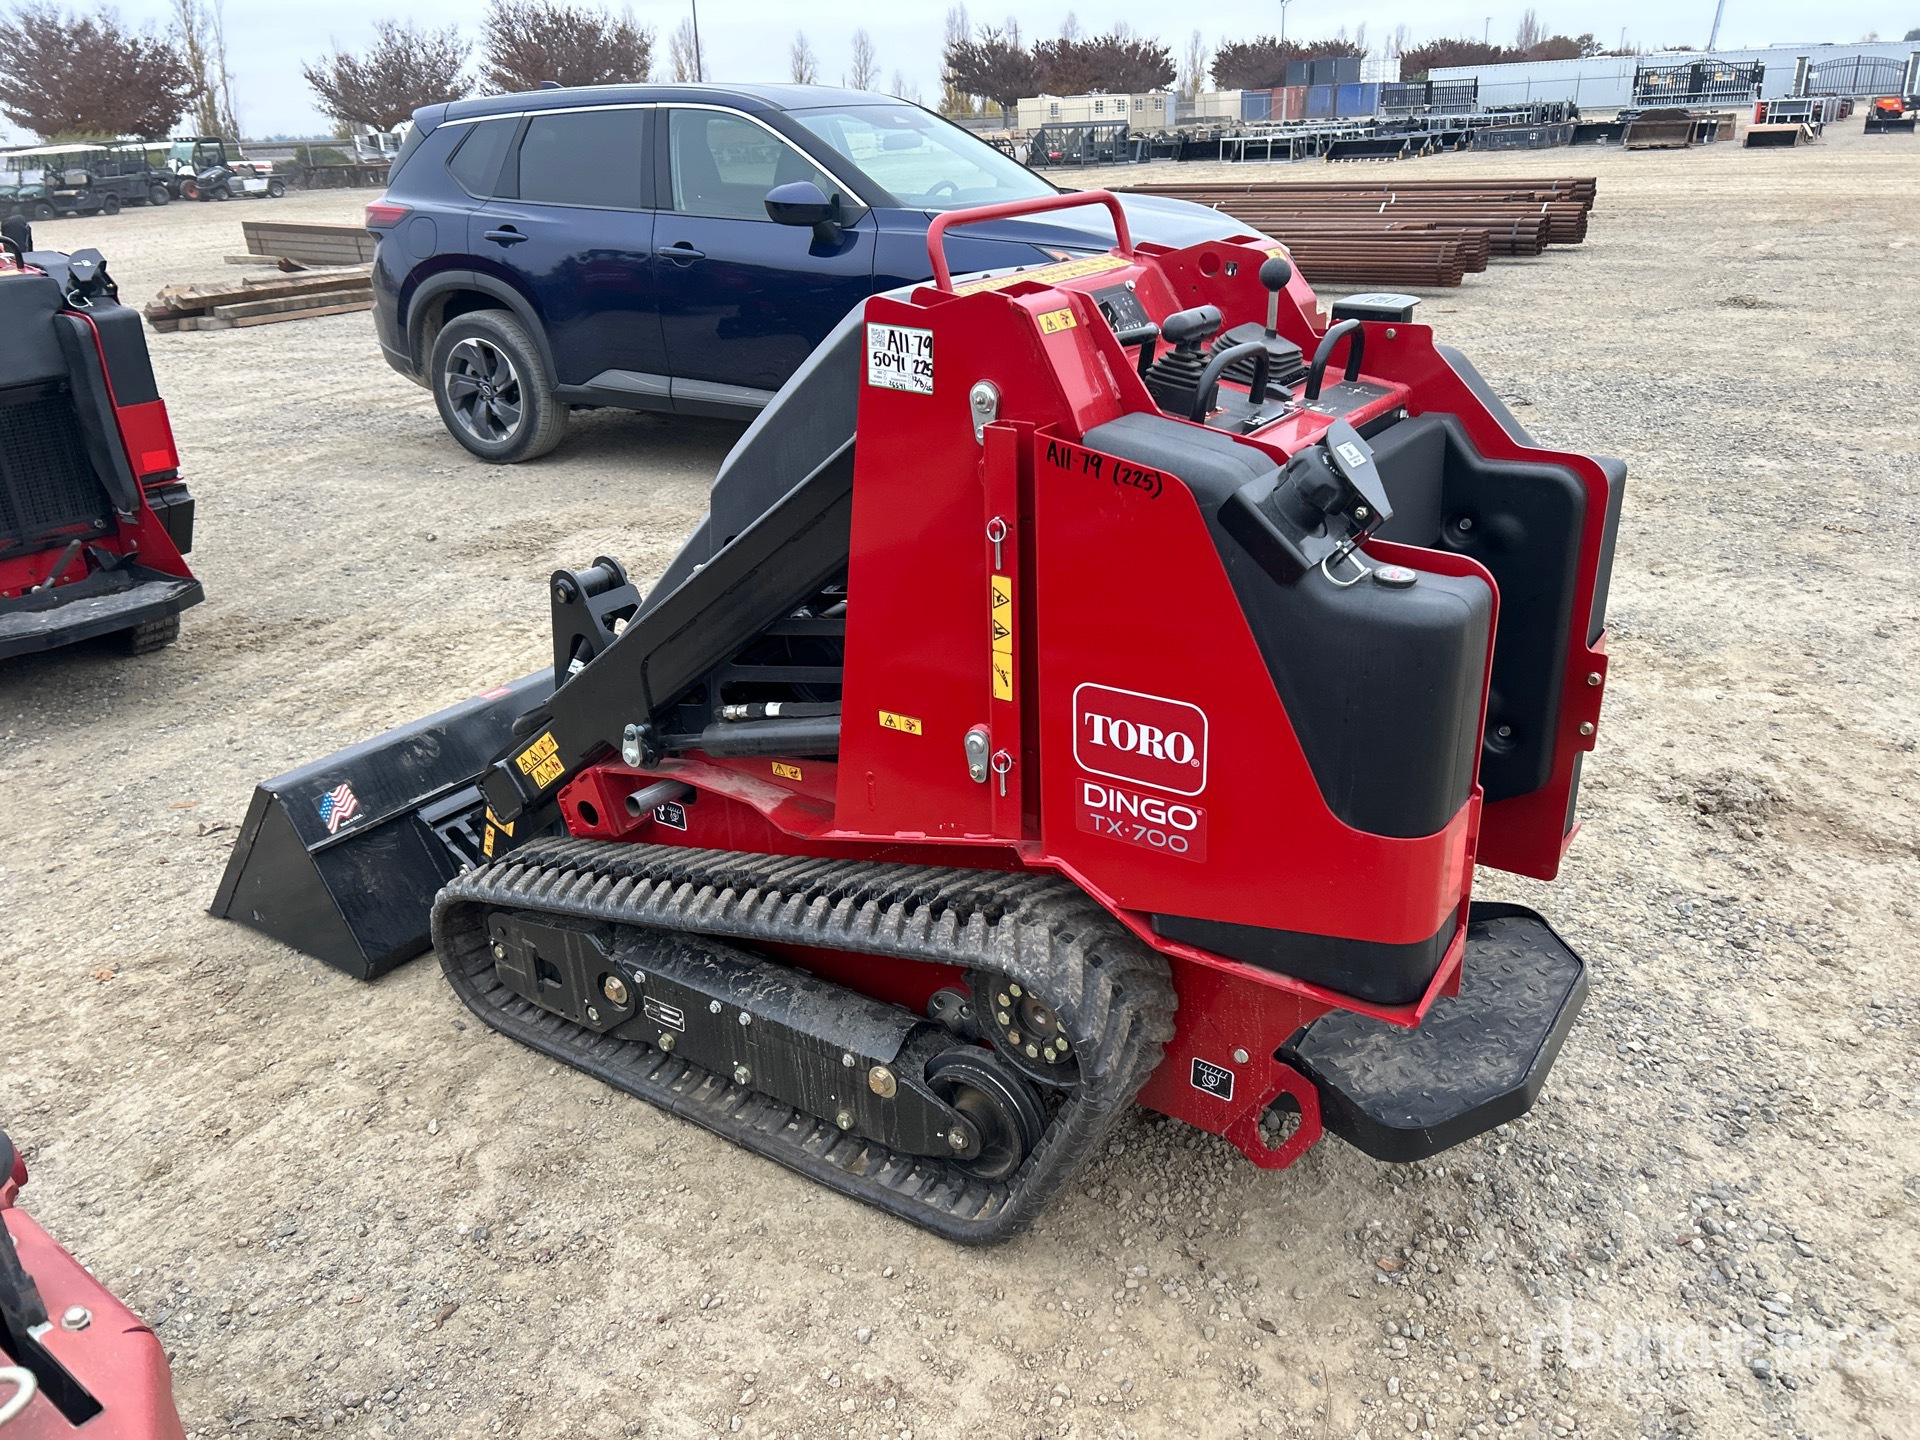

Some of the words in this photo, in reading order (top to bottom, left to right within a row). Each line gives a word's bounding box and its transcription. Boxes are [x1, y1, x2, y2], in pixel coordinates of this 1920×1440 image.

[873, 351, 905, 373] 5041
[913, 359, 933, 378] 225
[1113, 462, 1163, 499] (225)
[1084, 712, 1195, 765] TORO
[1083, 782, 1198, 831] DINGO
